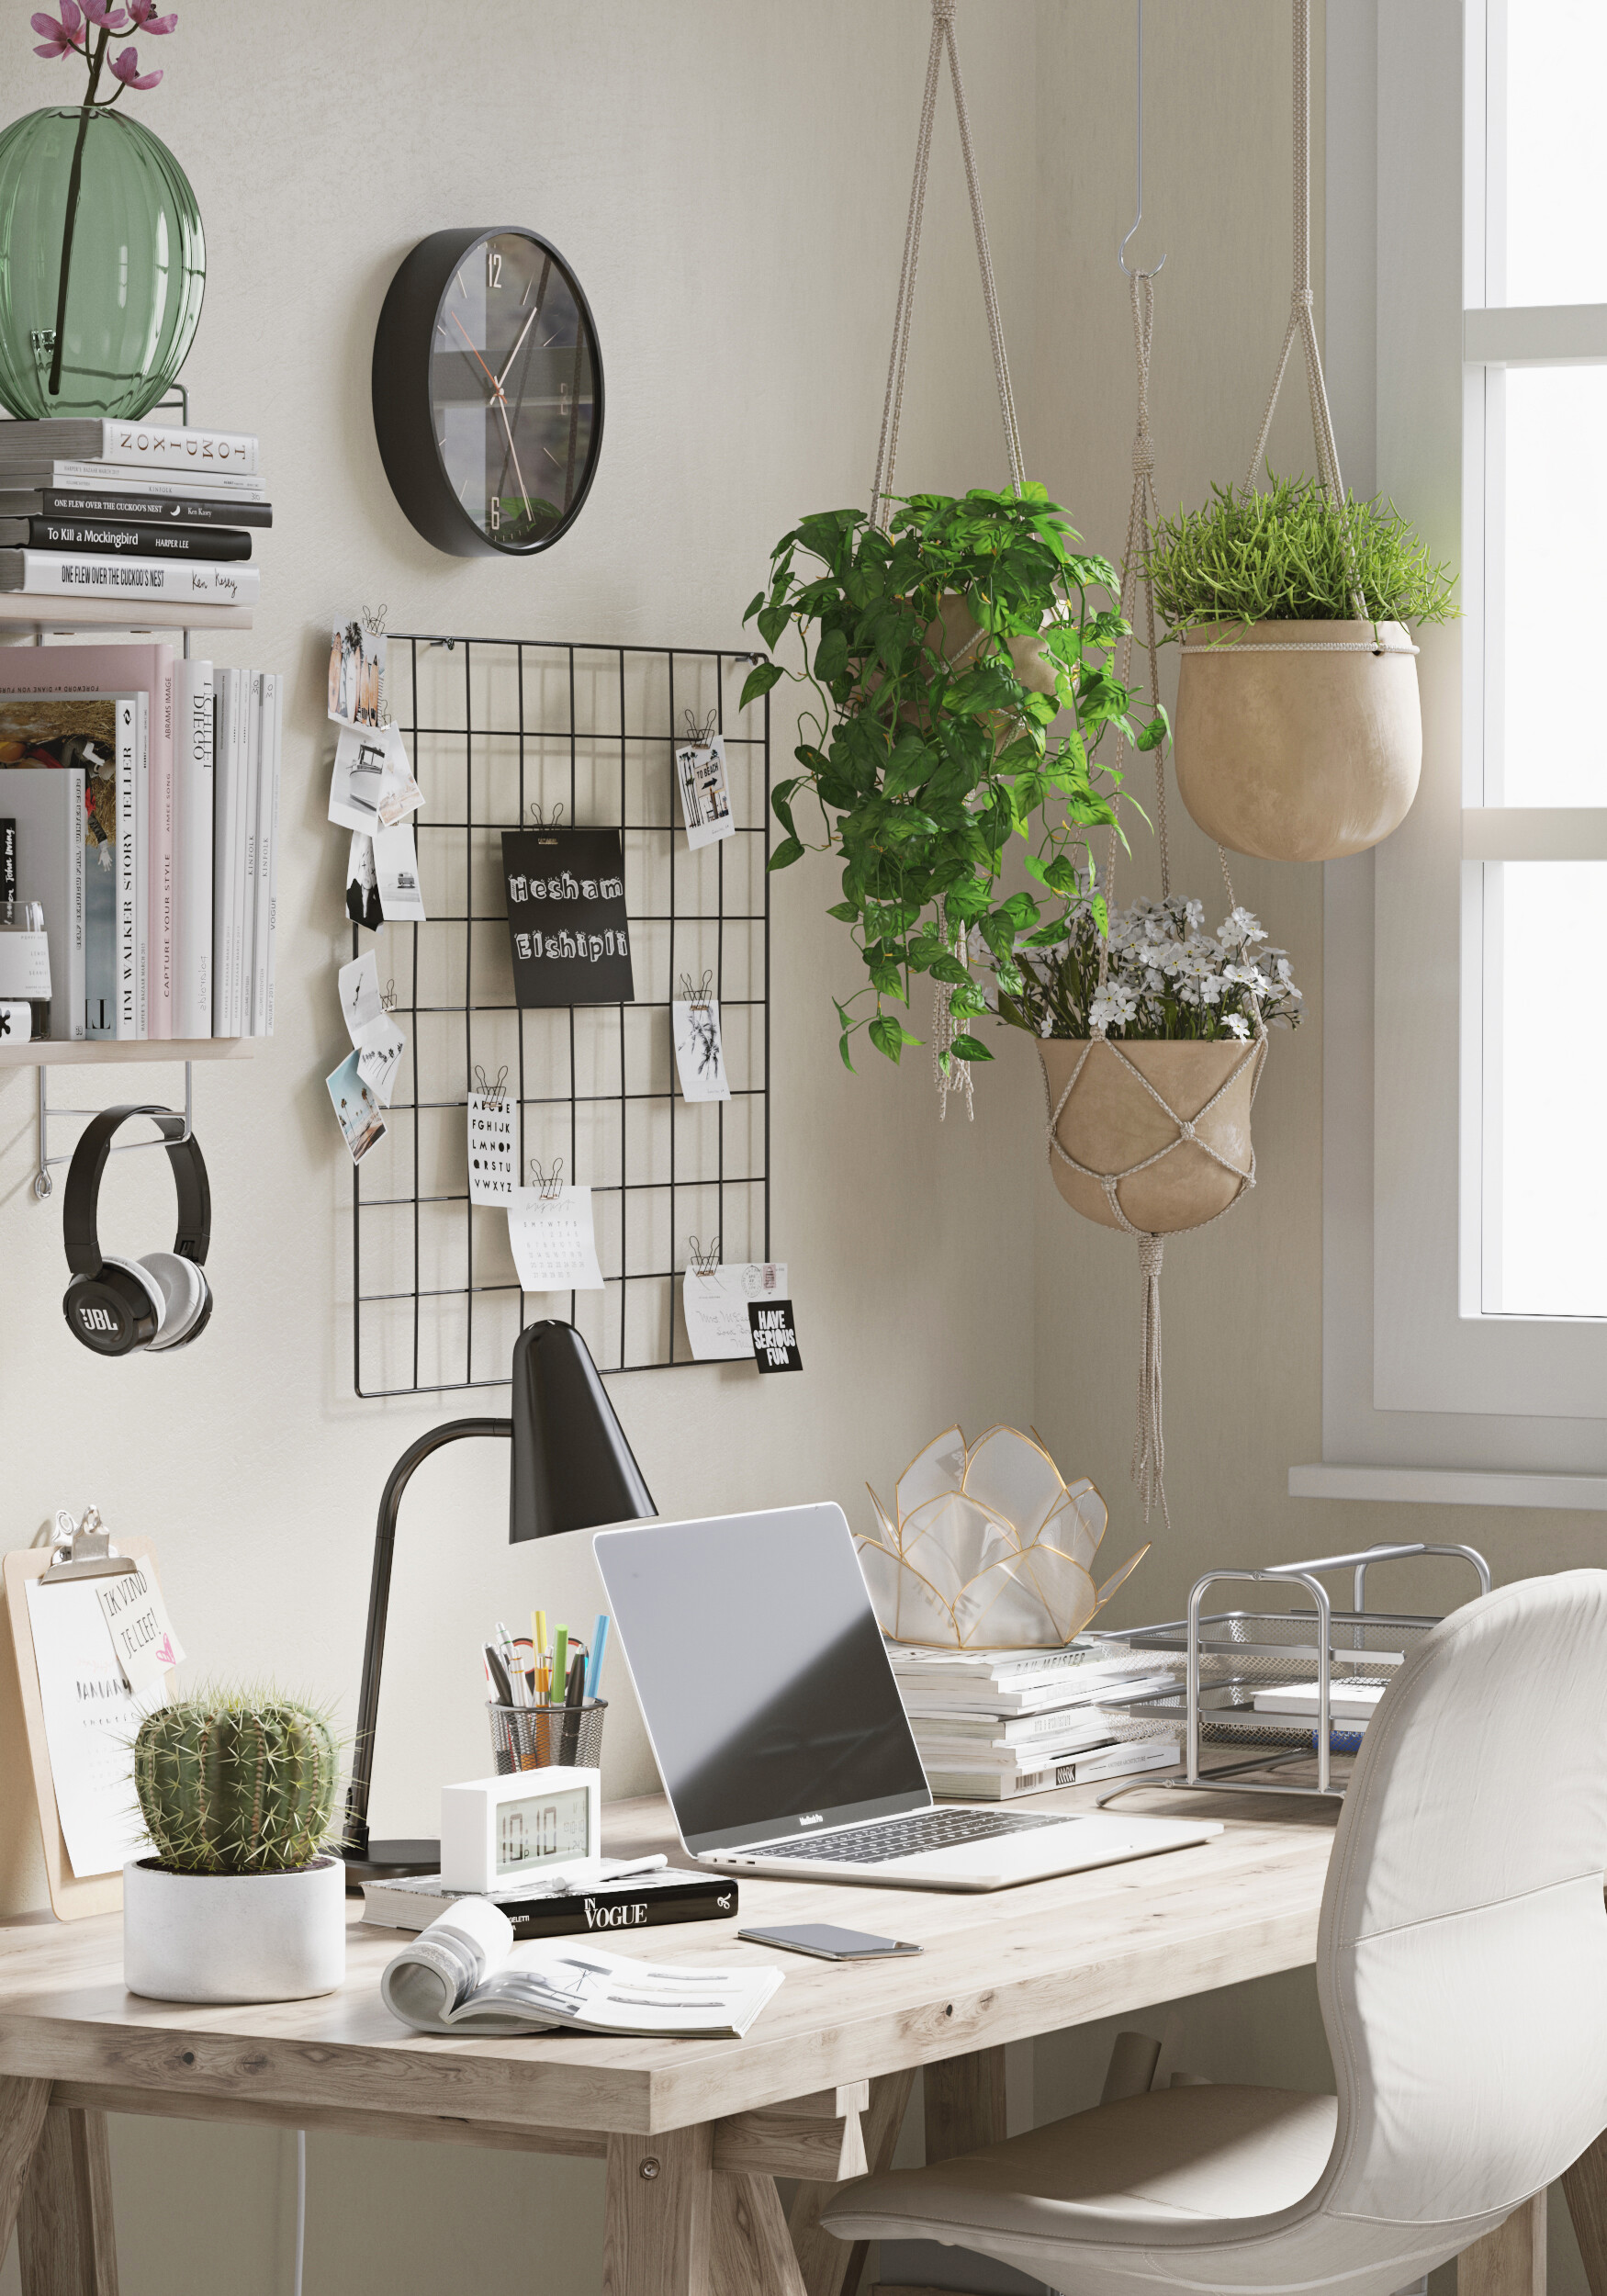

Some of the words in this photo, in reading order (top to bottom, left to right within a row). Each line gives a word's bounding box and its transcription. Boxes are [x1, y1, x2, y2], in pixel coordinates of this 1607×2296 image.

[488, 253, 502, 288] 12
[148, 486, 173, 494] KINFOLK
[54, 499, 67, 508] ONE
[68, 500, 84, 509] FLEW
[85, 501, 102, 510] OVER
[103, 501, 116, 511] THE
[116, 502, 147, 512] CUCKOO'S
[147, 504, 163, 513] NEST
[490, 496, 500, 531] 6
[48, 527, 59, 540] To
[61, 528, 74, 542] Kill
[76, 533, 82, 543] a
[84, 530, 139, 548] Mockingbird
[155, 538, 177, 548] HARPER
[178, 539, 189, 549] LEE
[62, 564, 73, 583] ONE
[74, 565, 90, 584] FLEW
[92, 567, 107, 585] OVER
[108, 568, 119, 585] THE
[120, 568, 149, 587] CUCKOO'S
[150, 569, 164, 588] NEST
[163, 677, 172, 703] IMAGE
[696, 771, 703, 779] TO
[704, 762, 719, 777] BEACH
[122, 747, 133, 822] TELLER
[4, 857, 14, 883] John
[122, 829, 133, 891] STORY
[163, 853, 171, 892] STYLE
[509, 871, 624, 903] Hesham
[163, 896, 171, 933] YOUR
[122, 900, 133, 980] WALKER
[163, 937, 171, 997] CAPTURE
[122, 989, 133, 1025] TIM
[81, 1308, 118, 1331] JBL
[758, 1311, 786, 1330] HAVE
[753, 1329, 795, 1350] SERIOUS
[766, 1346, 790, 1367] FUN
[104, 1589, 121, 1616] IK
[117, 1570, 148, 1606] VIND
[1057, 1764, 1075, 1784] MARK
[584, 1897, 597, 1911] IN
[584, 1903, 648, 1930] VOGUE
